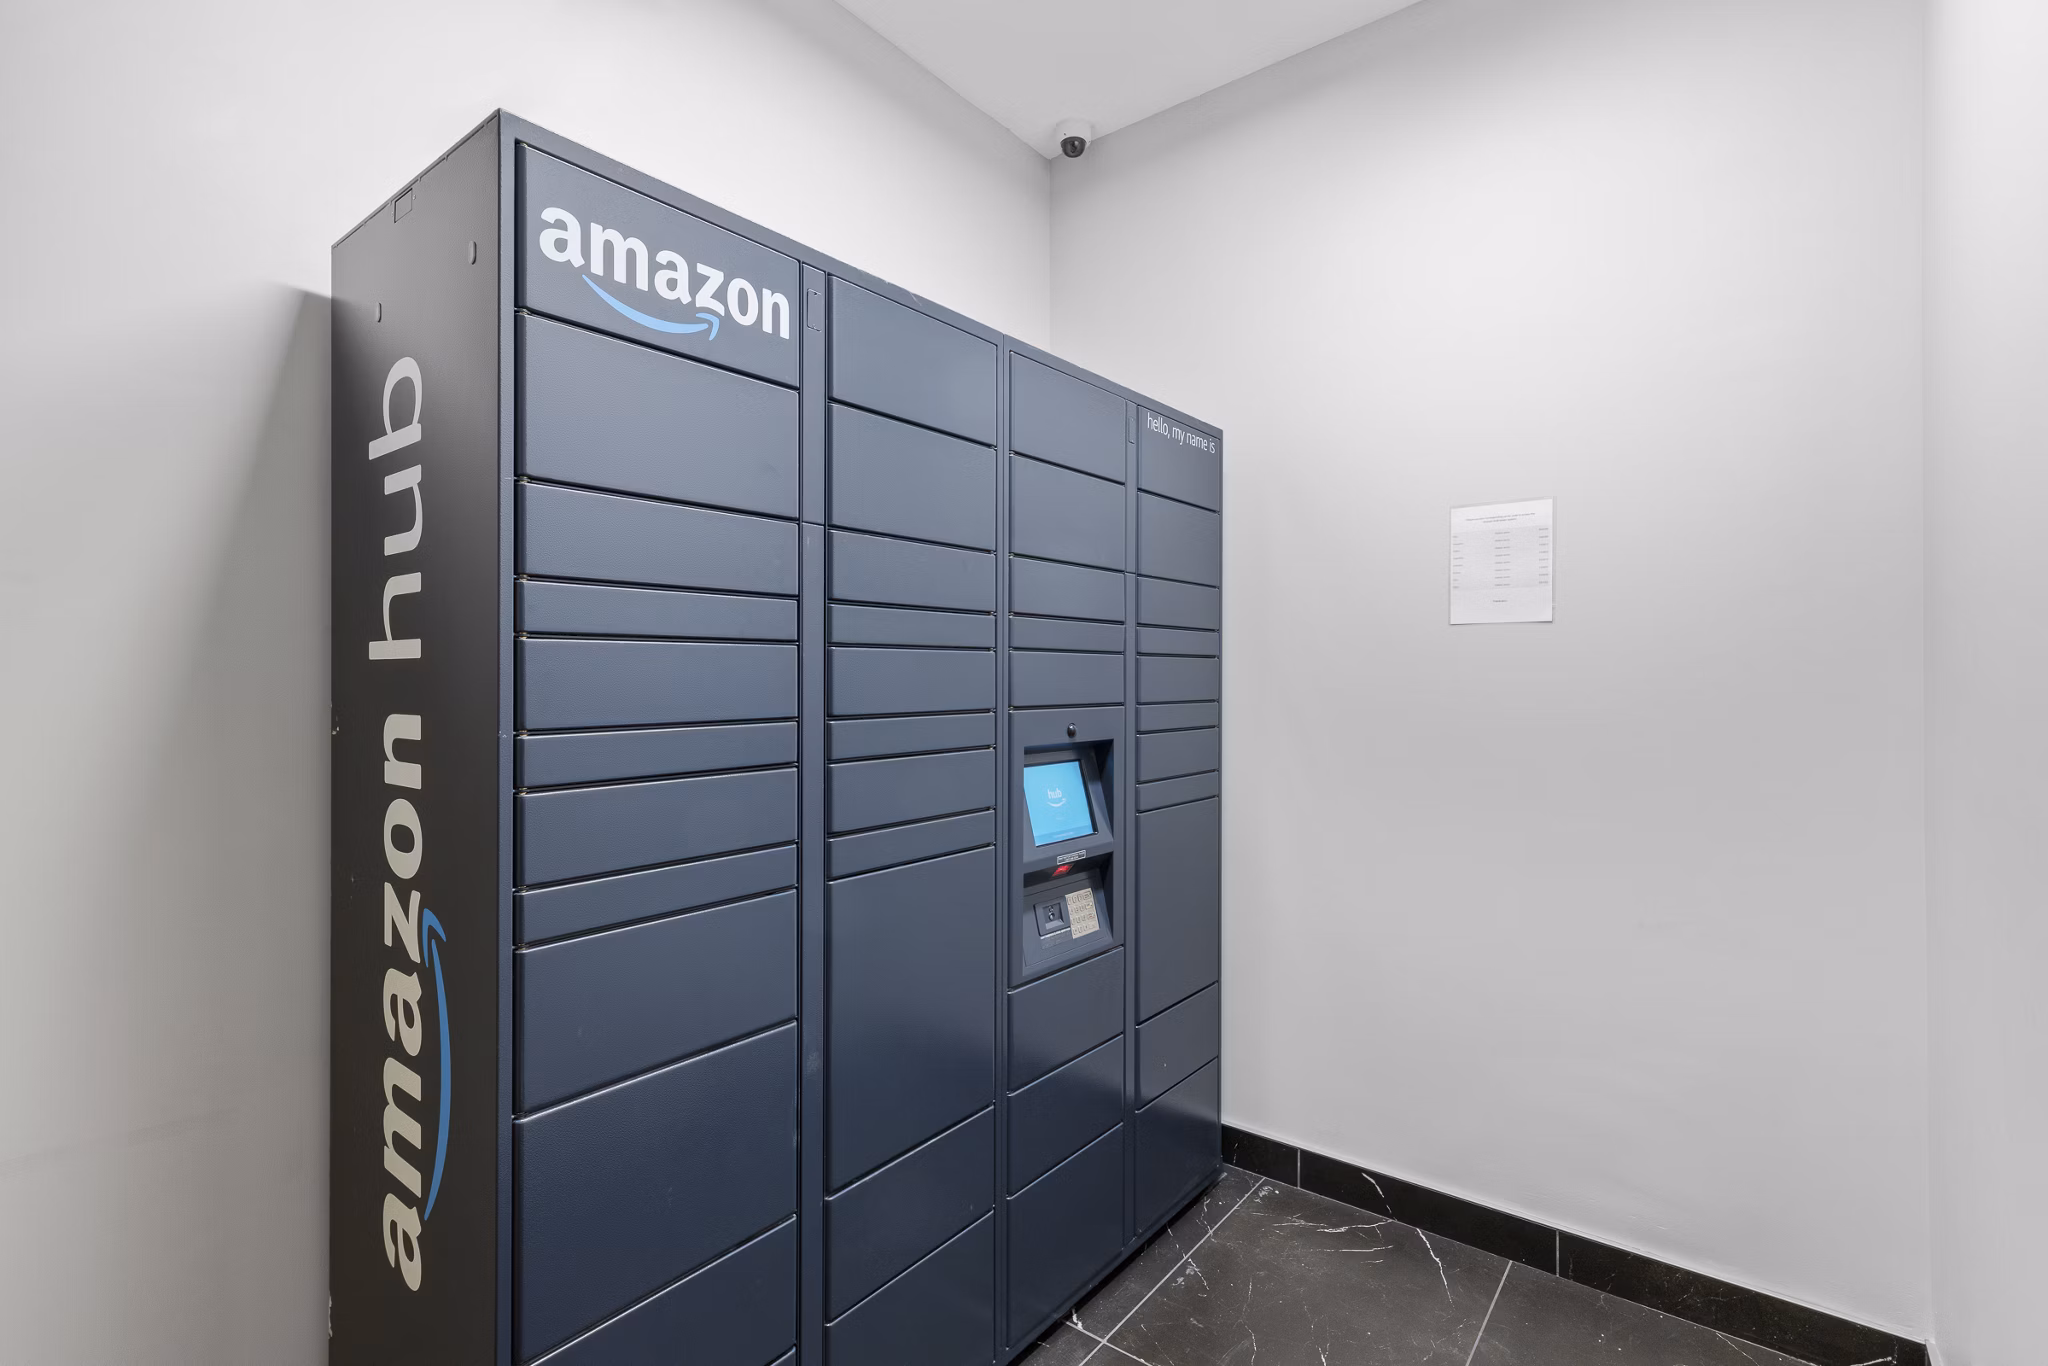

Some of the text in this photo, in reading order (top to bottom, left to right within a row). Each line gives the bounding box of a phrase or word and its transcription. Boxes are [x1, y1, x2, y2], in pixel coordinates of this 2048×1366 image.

[539, 206, 790, 340] amazon
[1147, 411, 1216, 454] hello, my name is
[368, 356, 424, 1292] amazon hub
[1047, 787, 1063, 799] hub
